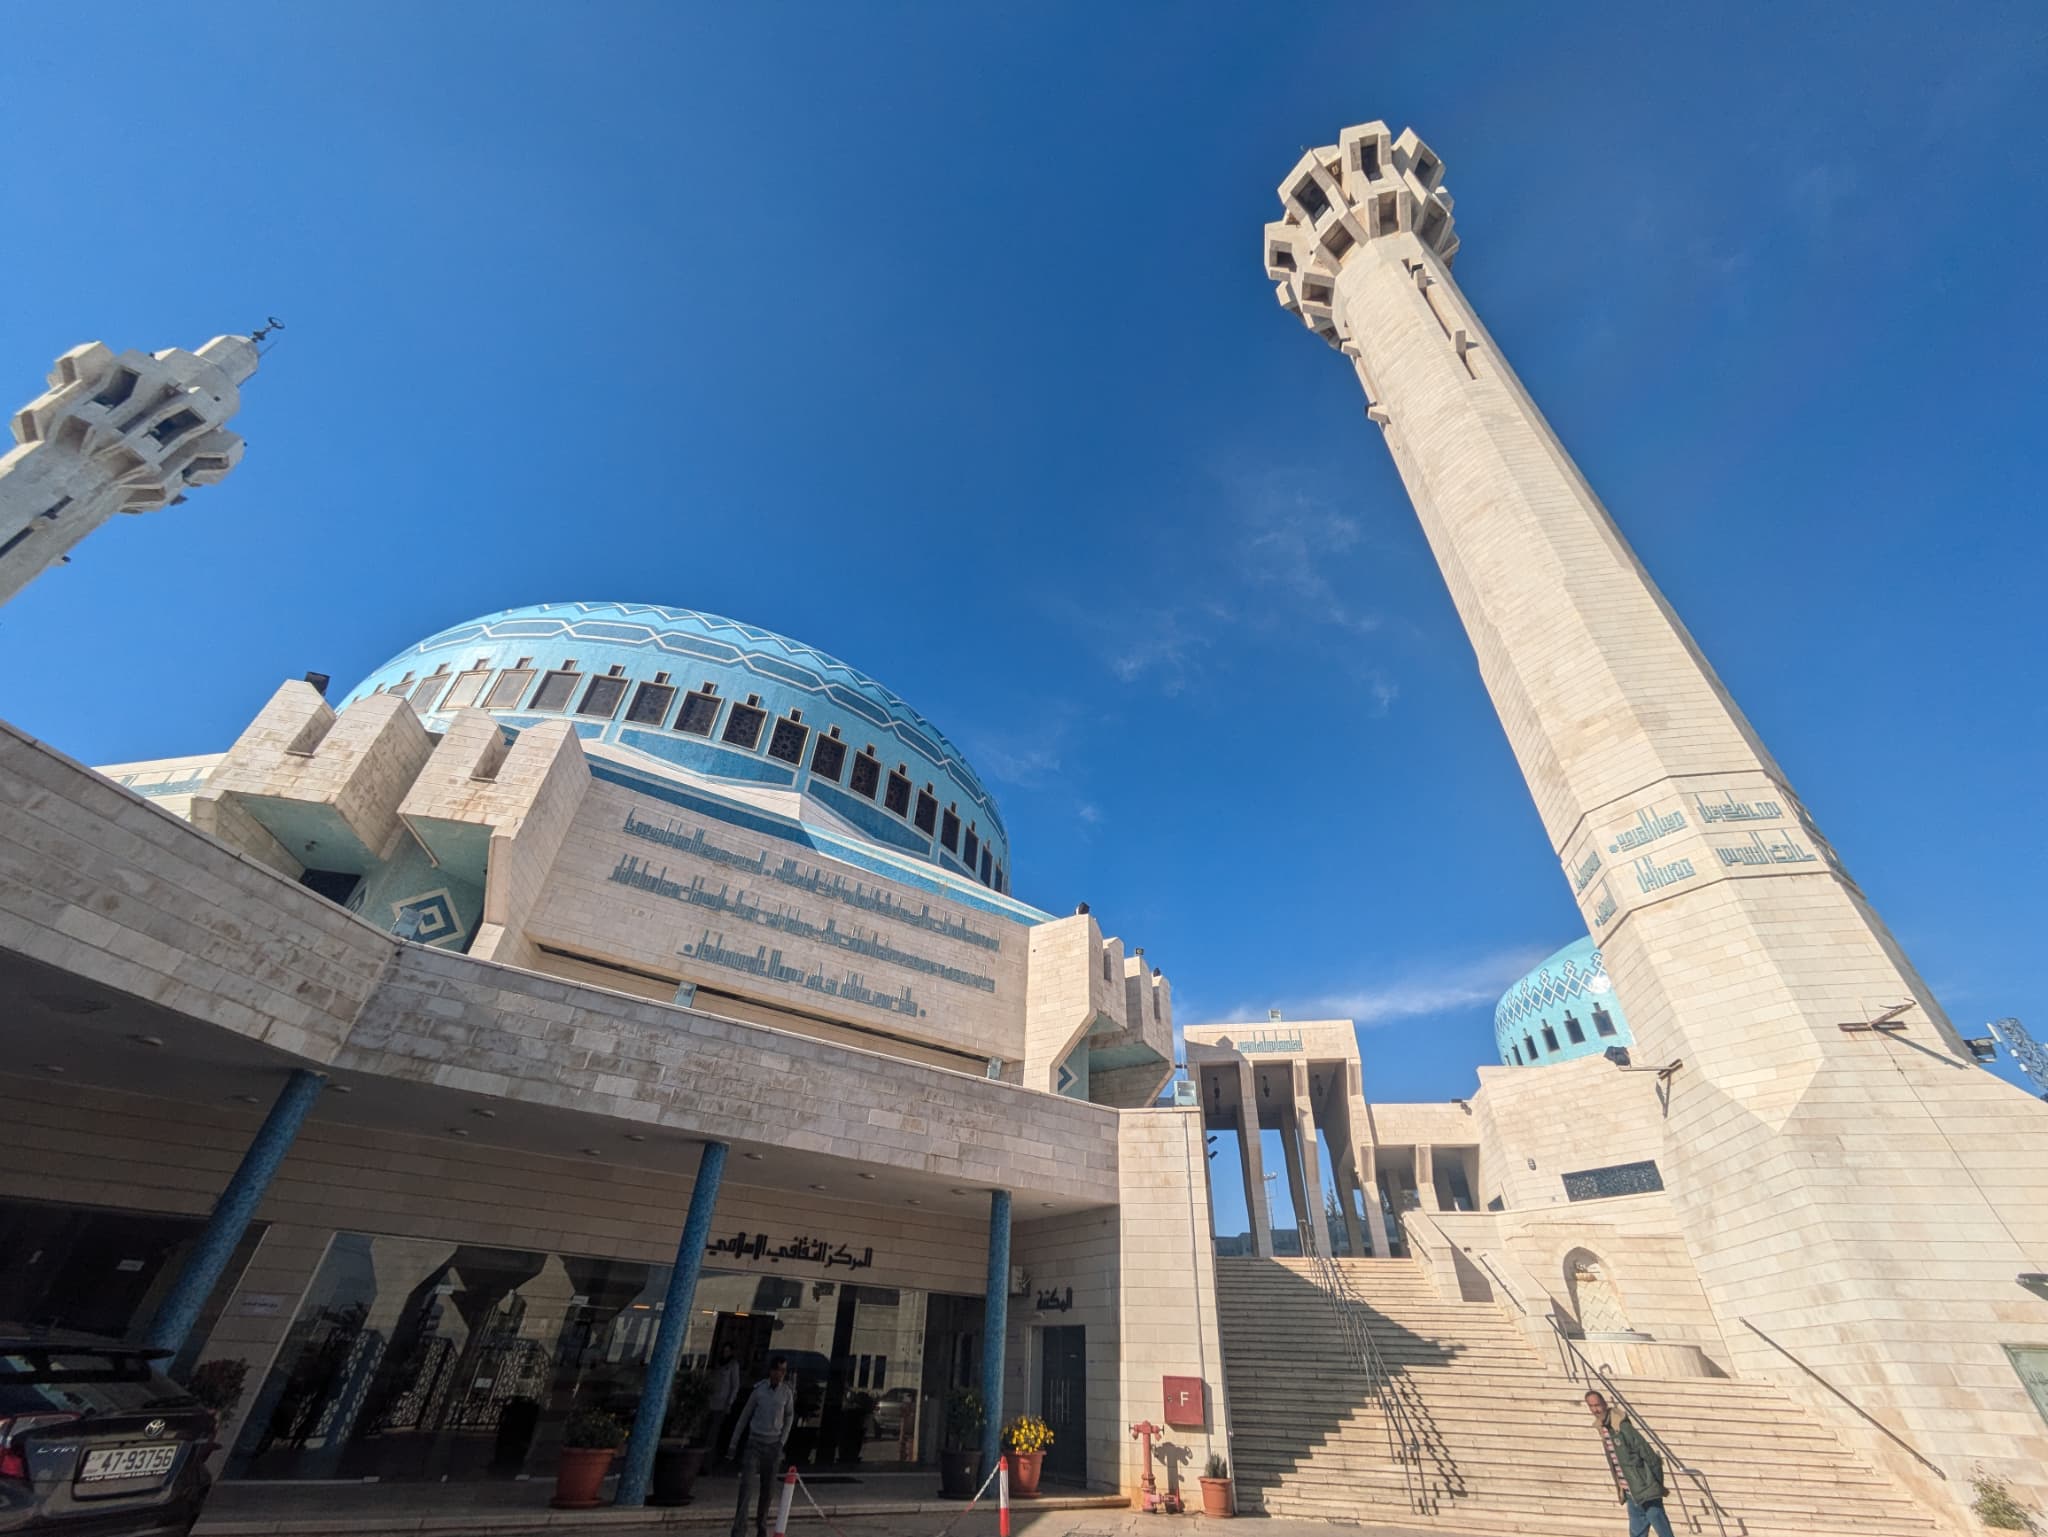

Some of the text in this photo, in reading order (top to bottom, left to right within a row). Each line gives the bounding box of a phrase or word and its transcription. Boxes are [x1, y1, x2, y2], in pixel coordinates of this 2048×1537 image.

[767, 1236, 828, 1263] الثقافي
[824, 1243, 873, 1271] المركز
[1179, 1391, 1190, 1407] F
